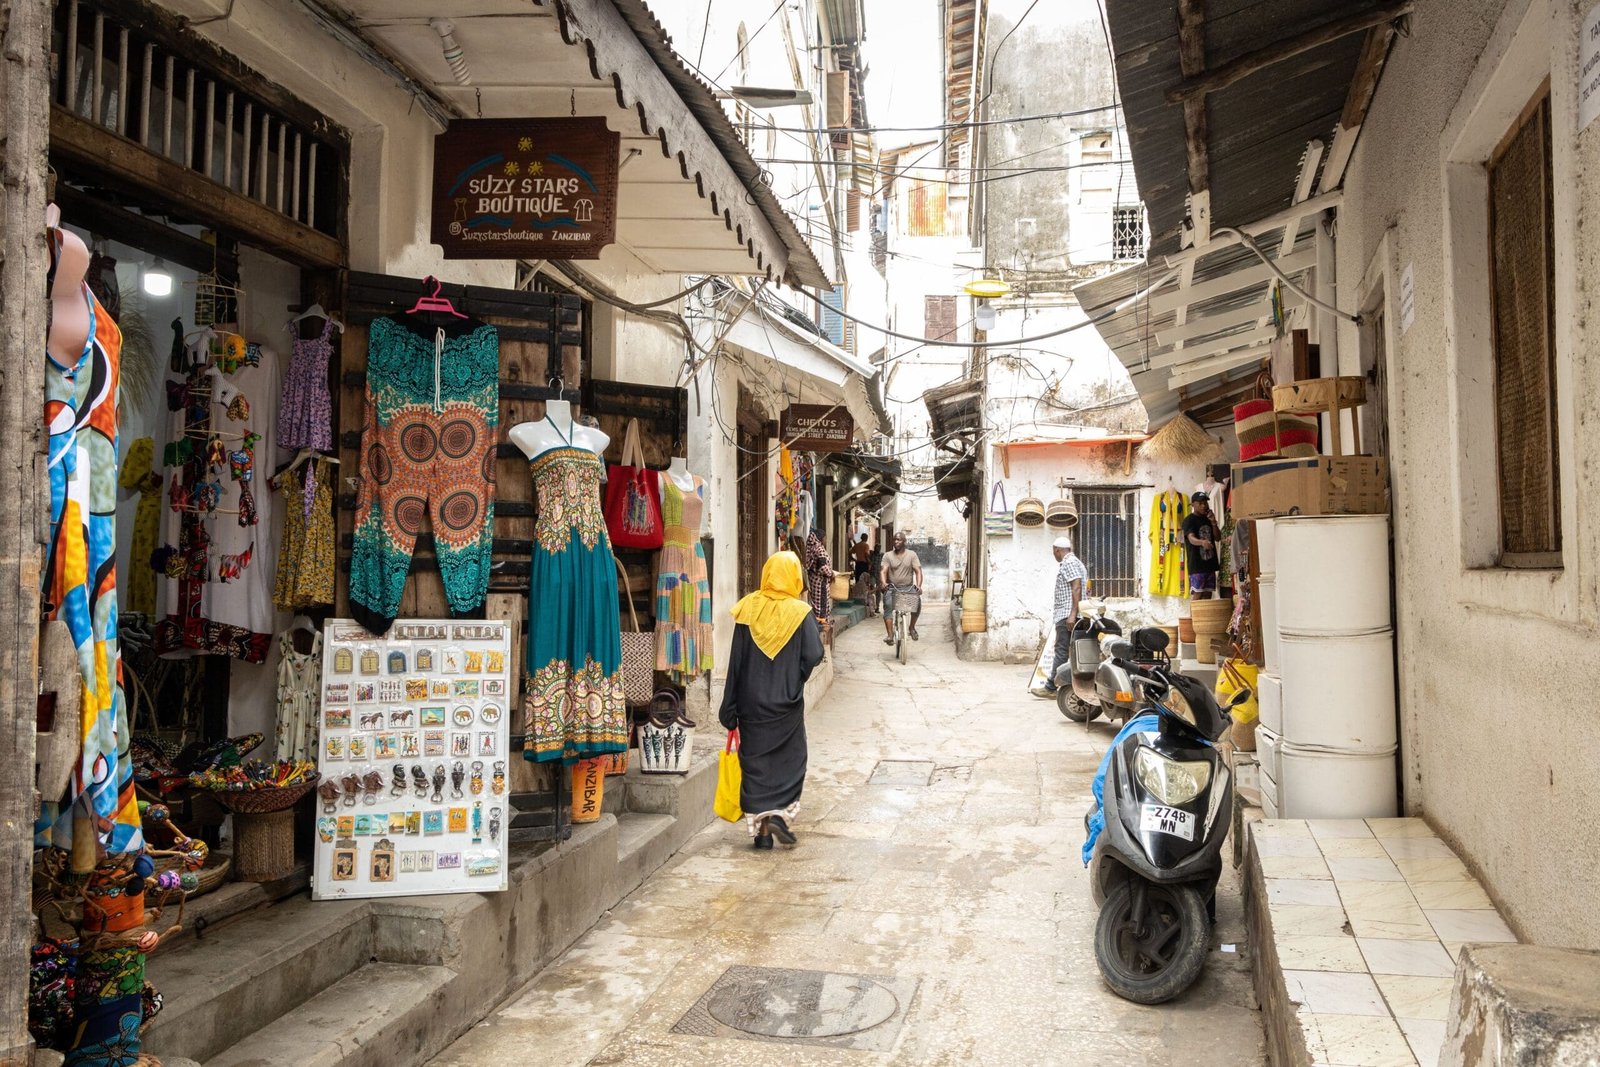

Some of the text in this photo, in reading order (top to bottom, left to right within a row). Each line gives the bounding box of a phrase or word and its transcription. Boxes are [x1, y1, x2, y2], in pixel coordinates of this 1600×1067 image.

[469, 174, 579, 195] SUZY STARS
[475, 194, 569, 218] BOUTIQUE
[462, 228, 591, 242] Suzystarsboutique ZANZIBAR
[582, 760, 597, 814] ANZIBAR
[1155, 807, 1186, 823] Z748
[1160, 819, 1176, 832] MN
